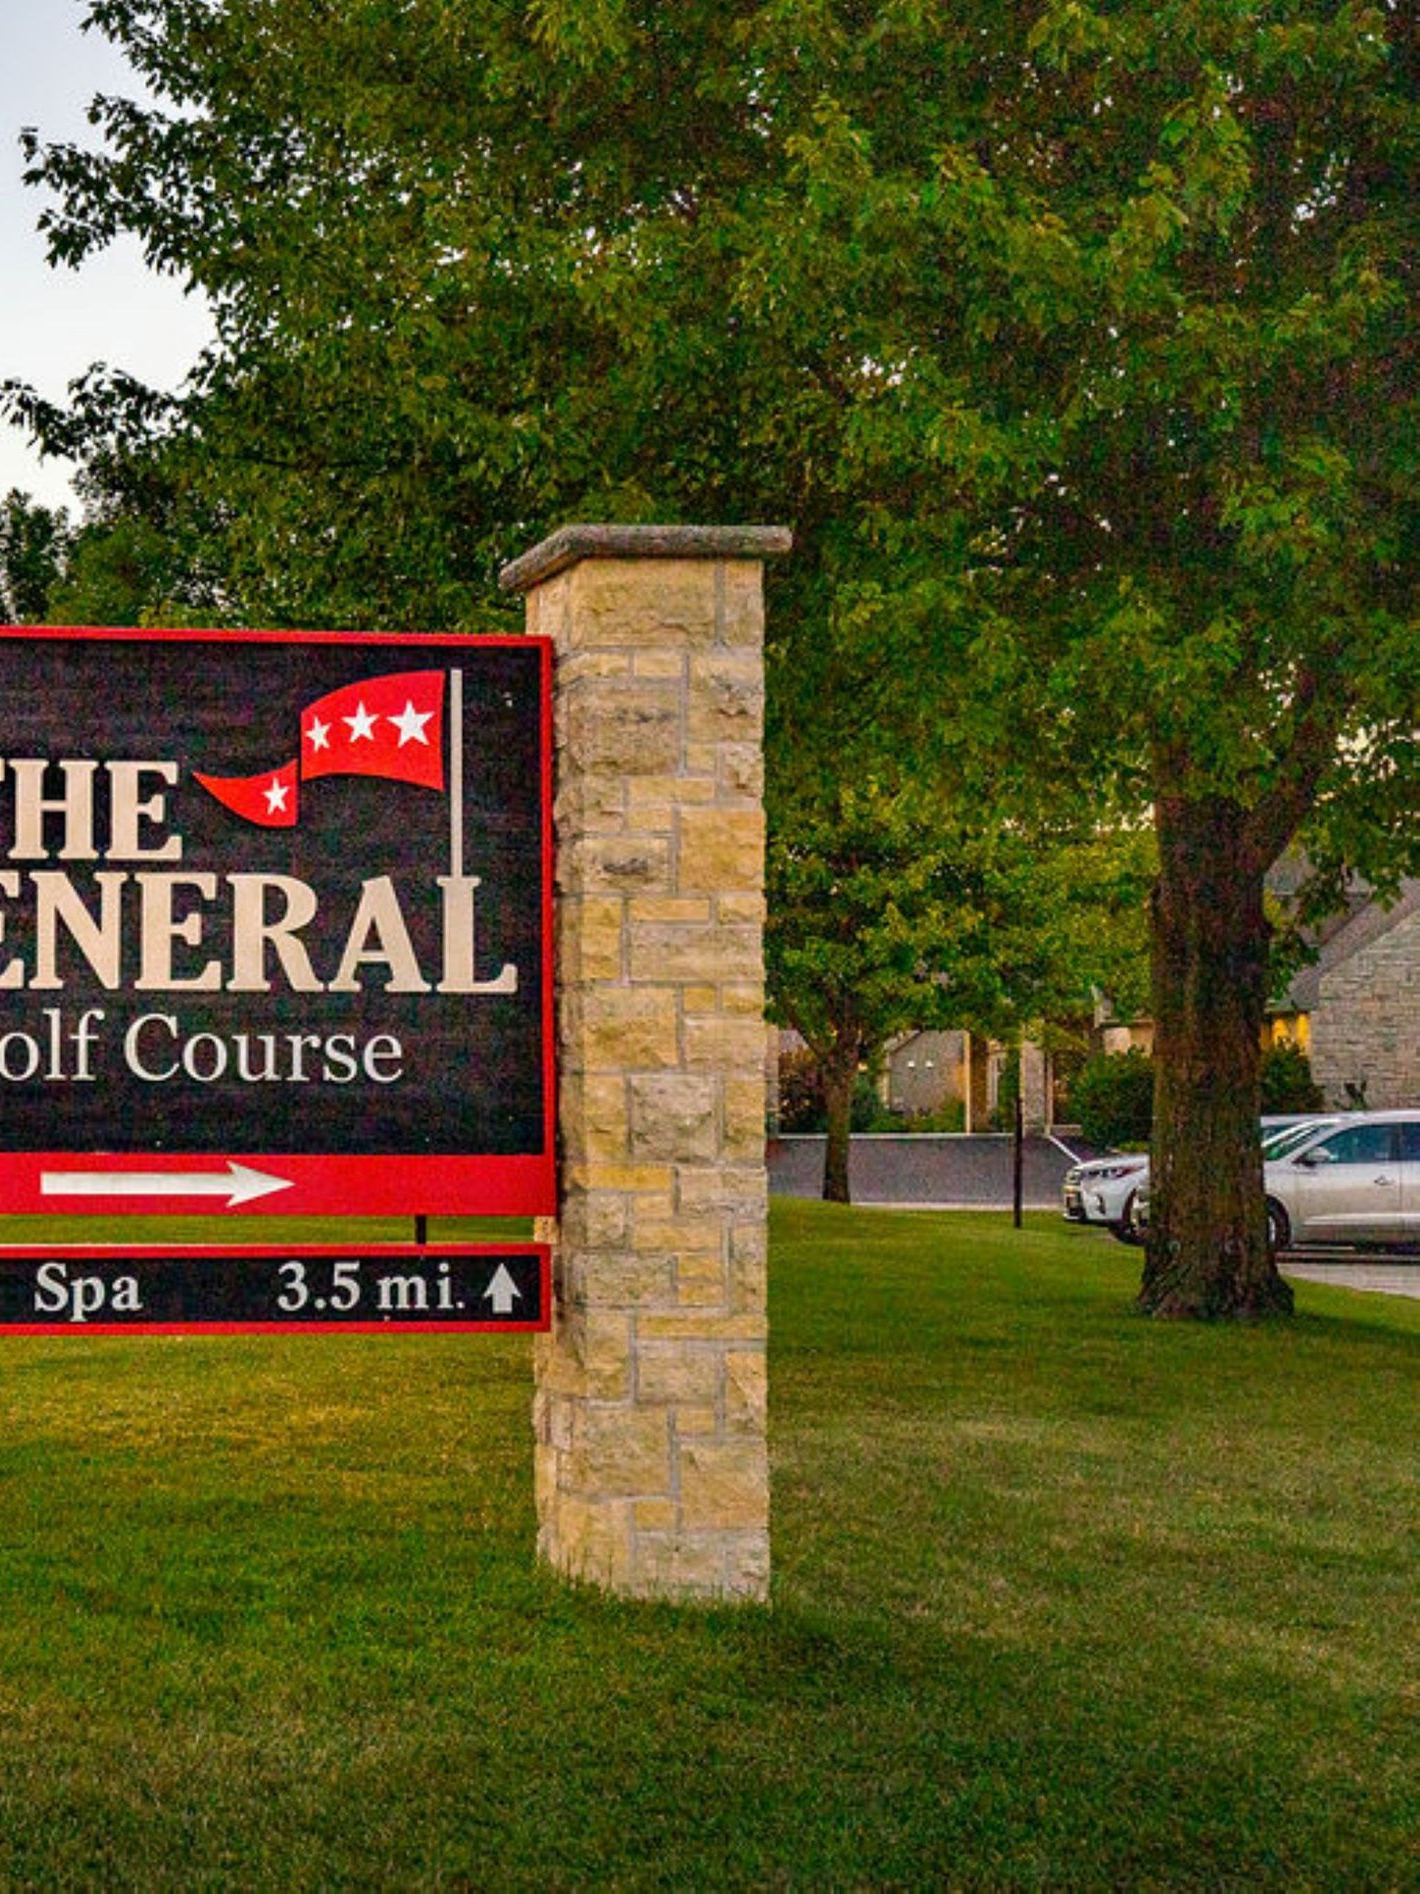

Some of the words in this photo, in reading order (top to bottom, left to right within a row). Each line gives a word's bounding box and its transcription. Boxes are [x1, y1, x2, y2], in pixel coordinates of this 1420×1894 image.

[124, 1012, 404, 1083] Course
[34, 1263, 144, 1323] Spa
[276, 1260, 362, 1312] 3.5
[376, 1262, 466, 1310] mi.
